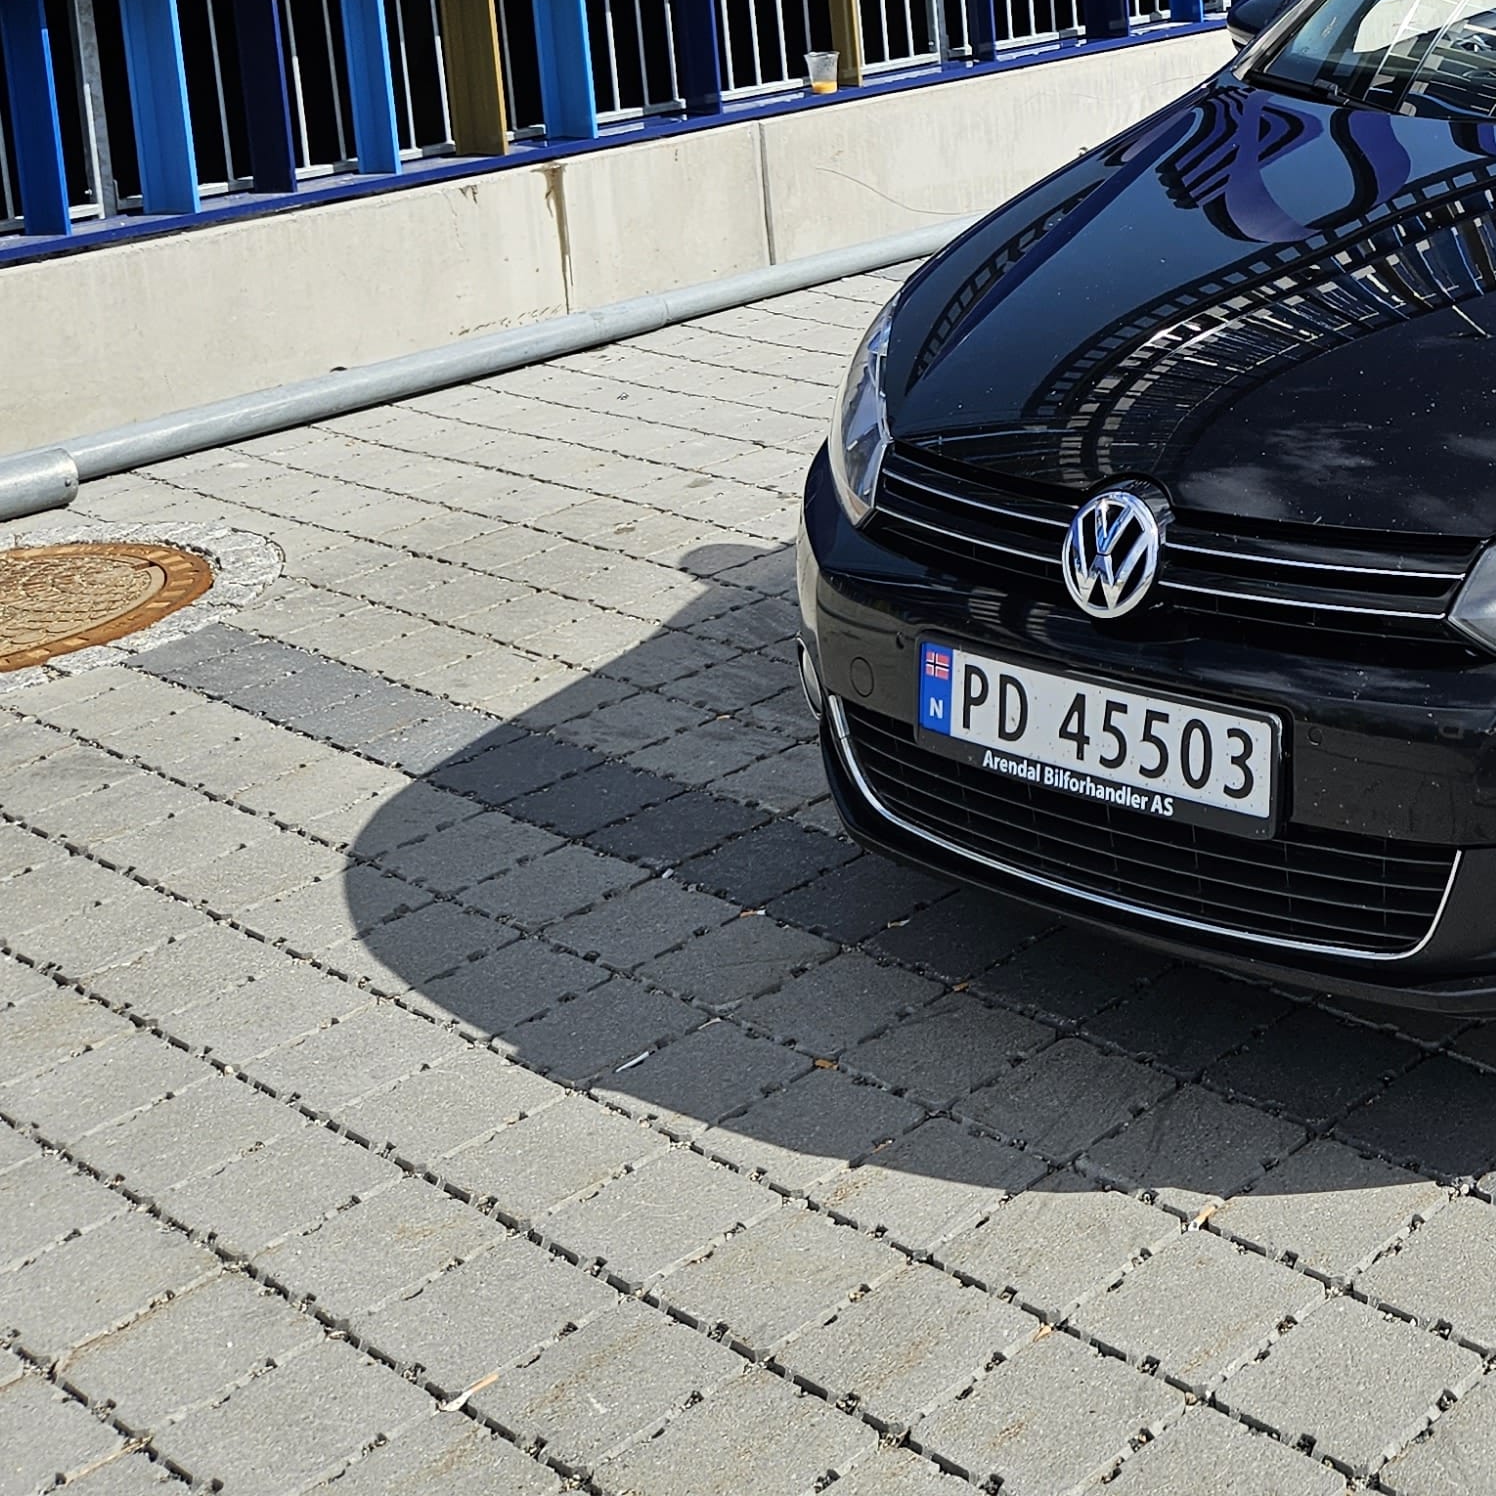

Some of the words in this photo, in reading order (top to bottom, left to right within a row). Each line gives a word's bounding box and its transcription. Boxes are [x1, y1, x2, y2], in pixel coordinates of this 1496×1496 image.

[929, 696, 944, 720] N
[961, 663, 1029, 743] PD
[1058, 692, 1255, 801] 45503
[982, 749, 1041, 783] Arendal
[1044, 766, 1148, 811] Bilforhandler
[1150, 795, 1174, 817] AS
